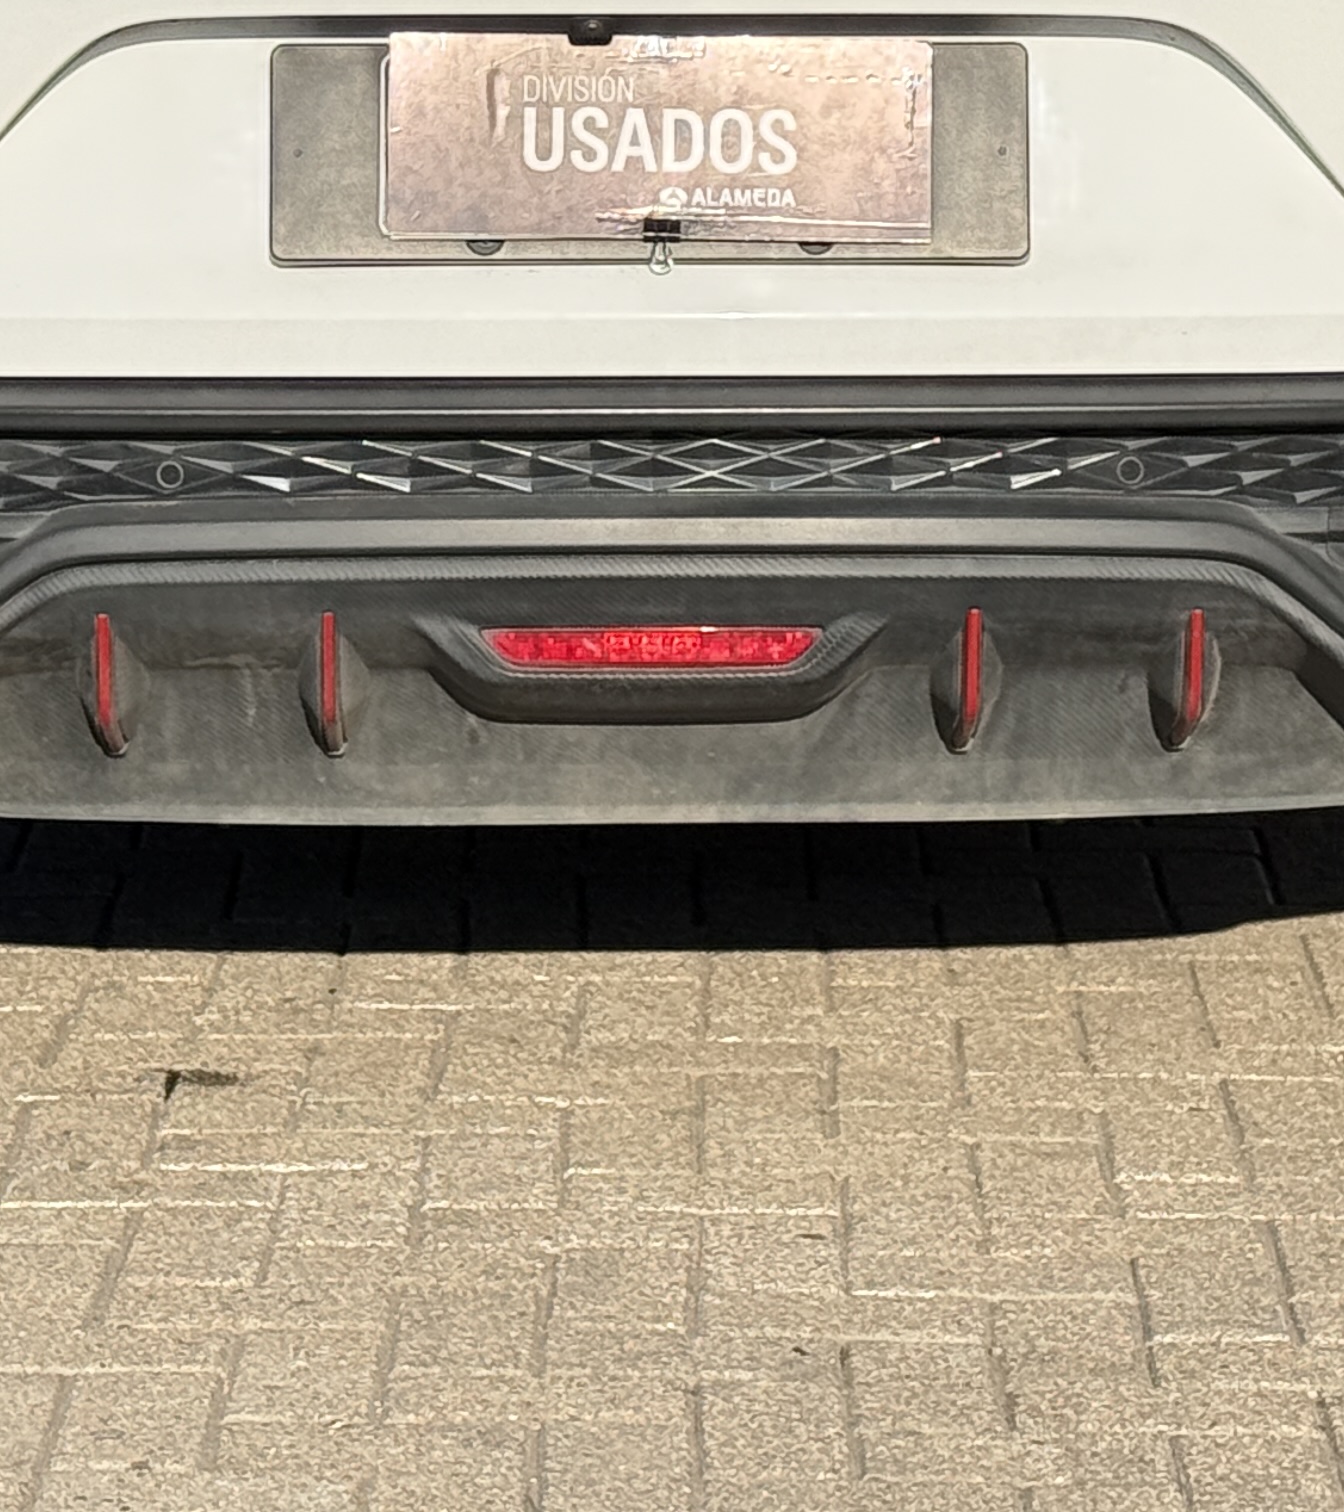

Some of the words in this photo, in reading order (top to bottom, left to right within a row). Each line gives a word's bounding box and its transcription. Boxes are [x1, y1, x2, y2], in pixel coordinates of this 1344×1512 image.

[521, 70, 635, 104] DIVISIÓN
[521, 106, 798, 176] USADOS
[690, 186, 796, 209] ALAMEDA
